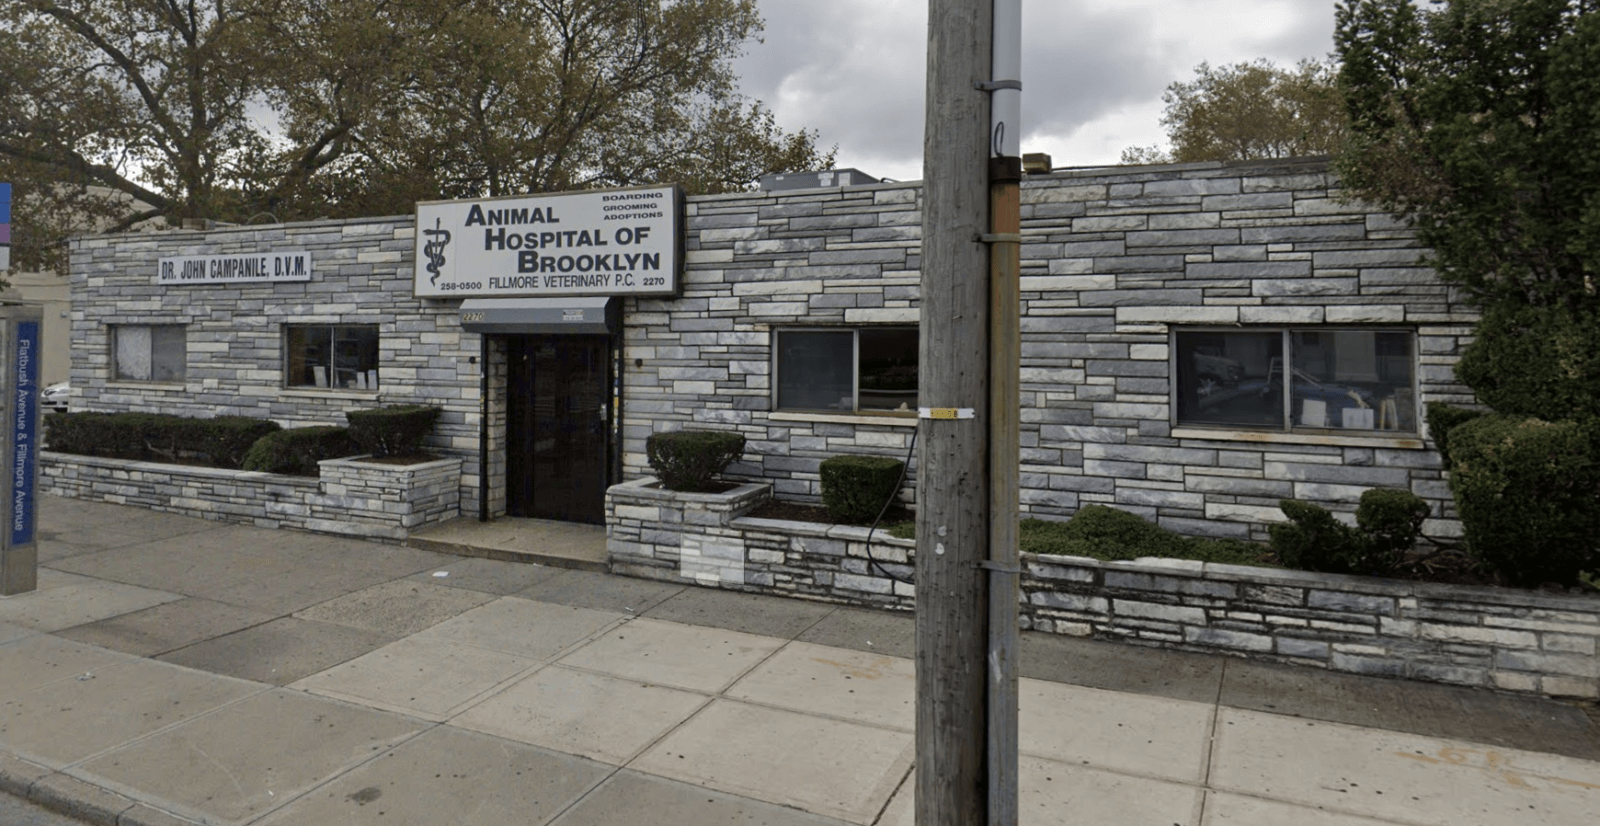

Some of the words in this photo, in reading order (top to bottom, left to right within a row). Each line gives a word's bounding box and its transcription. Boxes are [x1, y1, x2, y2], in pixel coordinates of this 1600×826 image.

[602, 192, 663, 202] BOARDING
[464, 204, 560, 227] ANIMAL
[603, 203, 658, 212] GROOMING
[603, 211, 663, 221] ADOPTIONS
[484, 227, 608, 251] HOSPITAL
[614, 226, 651, 246] OF
[161, 261, 177, 280] DR.
[181, 260, 206, 280] JOHN
[210, 257, 270, 279] CAMPANILE,
[274, 256, 307, 277] D.V.M.
[517, 250, 661, 273] BROOKLYN
[440, 281, 482, 291] 258-0500
[488, 275, 539, 289] FILLMORE
[543, 273, 611, 288] VETERINARY
[615, 272, 636, 287] P.C.
[643, 277, 665, 286] 2270
[463, 312, 485, 321] 2270
[18, 339, 30, 387] Flatbush
[17, 389, 29, 430] Avenue
[17, 432, 28, 441] &
[15, 443, 28, 488] Fillmore
[14, 490, 26, 531] Avenue
